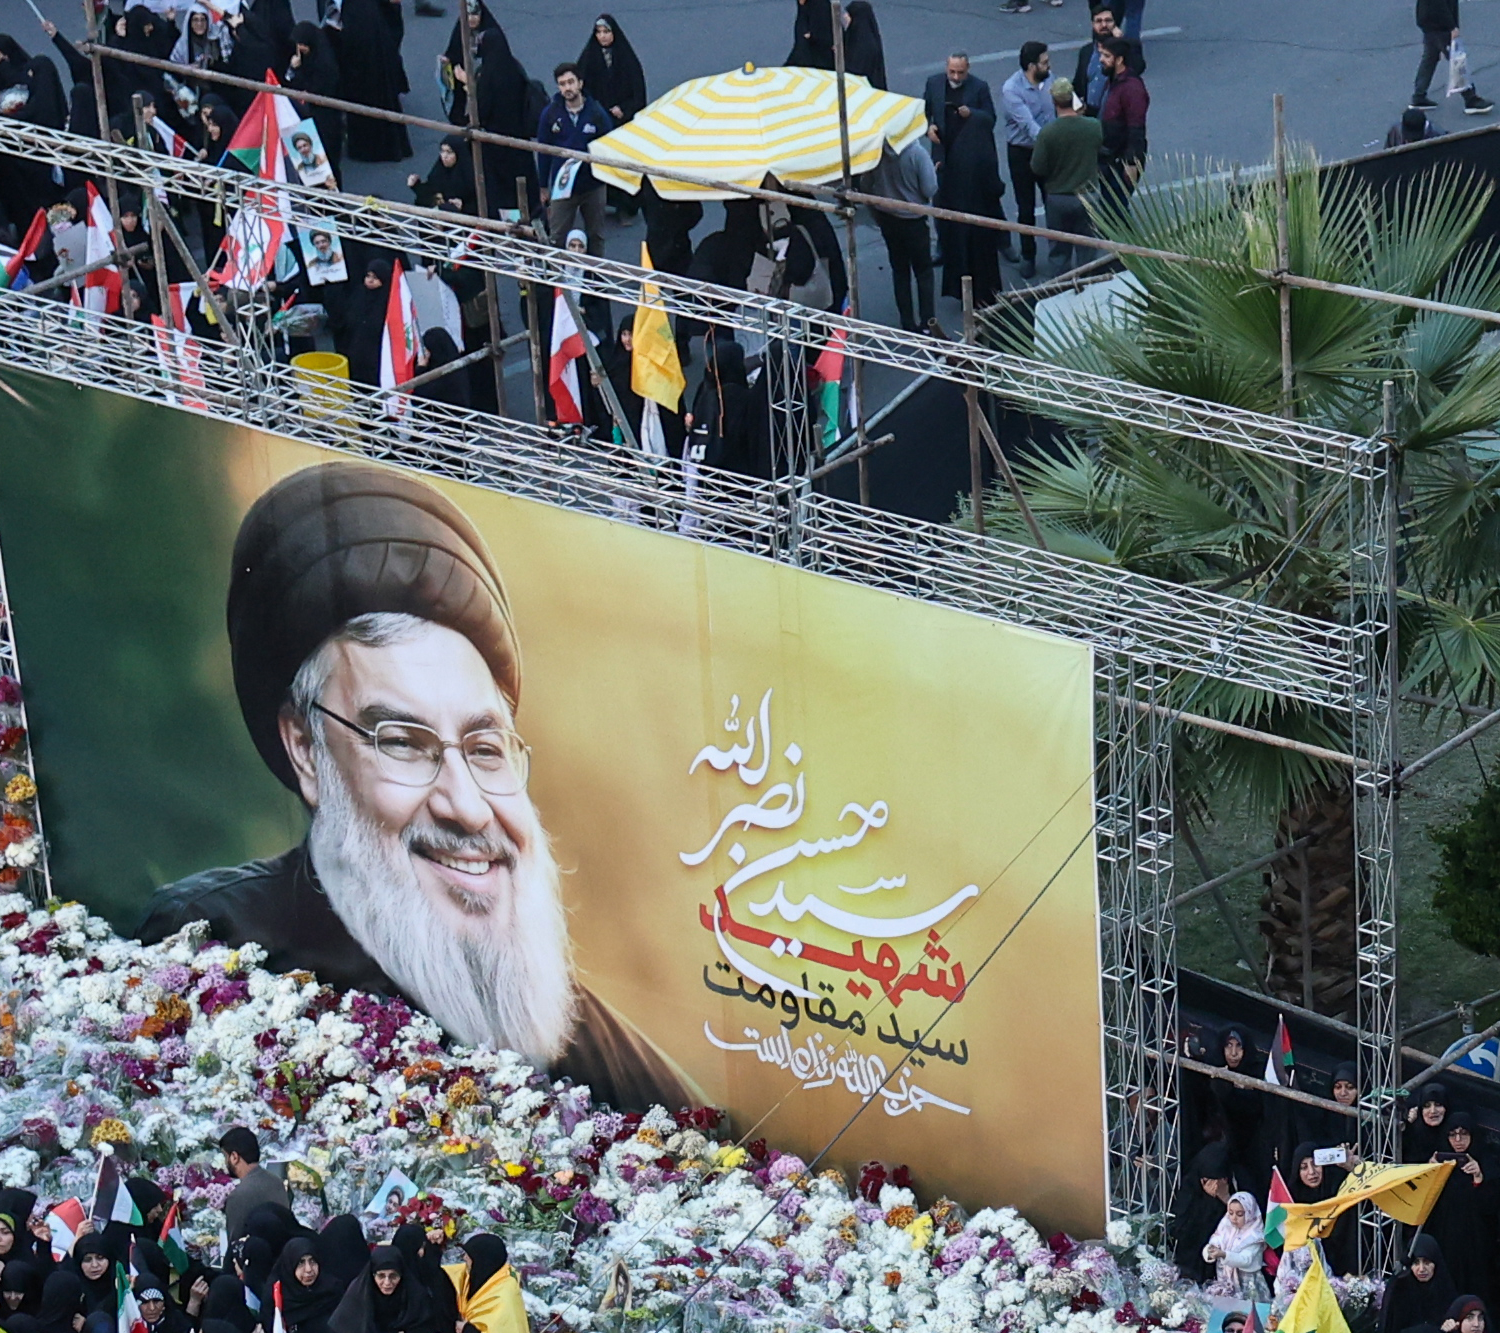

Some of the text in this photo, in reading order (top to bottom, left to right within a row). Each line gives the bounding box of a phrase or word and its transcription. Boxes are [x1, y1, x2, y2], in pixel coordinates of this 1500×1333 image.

[699, 884, 967, 1008] شهید
[703, 961, 970, 1068] سید مقاومت
